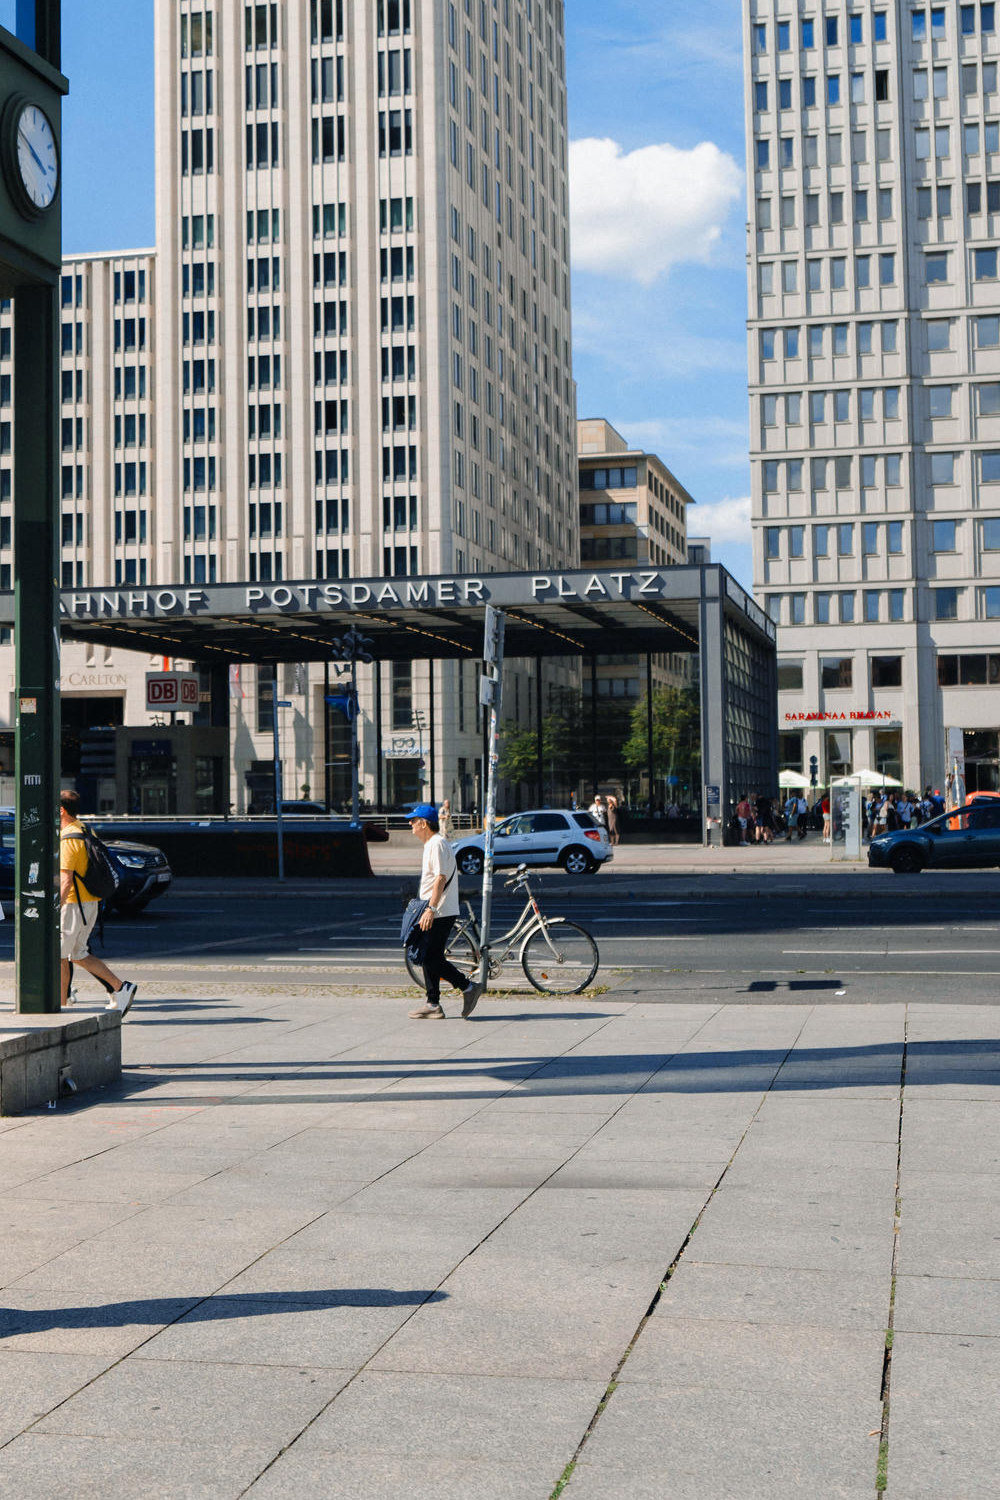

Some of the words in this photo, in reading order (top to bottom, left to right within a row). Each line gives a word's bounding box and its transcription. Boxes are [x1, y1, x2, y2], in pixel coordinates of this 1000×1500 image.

[60, 589, 203, 614] HNHOF
[245, 579, 484, 607] POTSDAMER
[531, 571, 660, 597] PLATZ
[150, 682, 175, 700] DB
[183, 682, 197, 700] DB
[784, 711, 847, 721] SARAVANAA
[849, 710, 892, 720] BHAVAN
